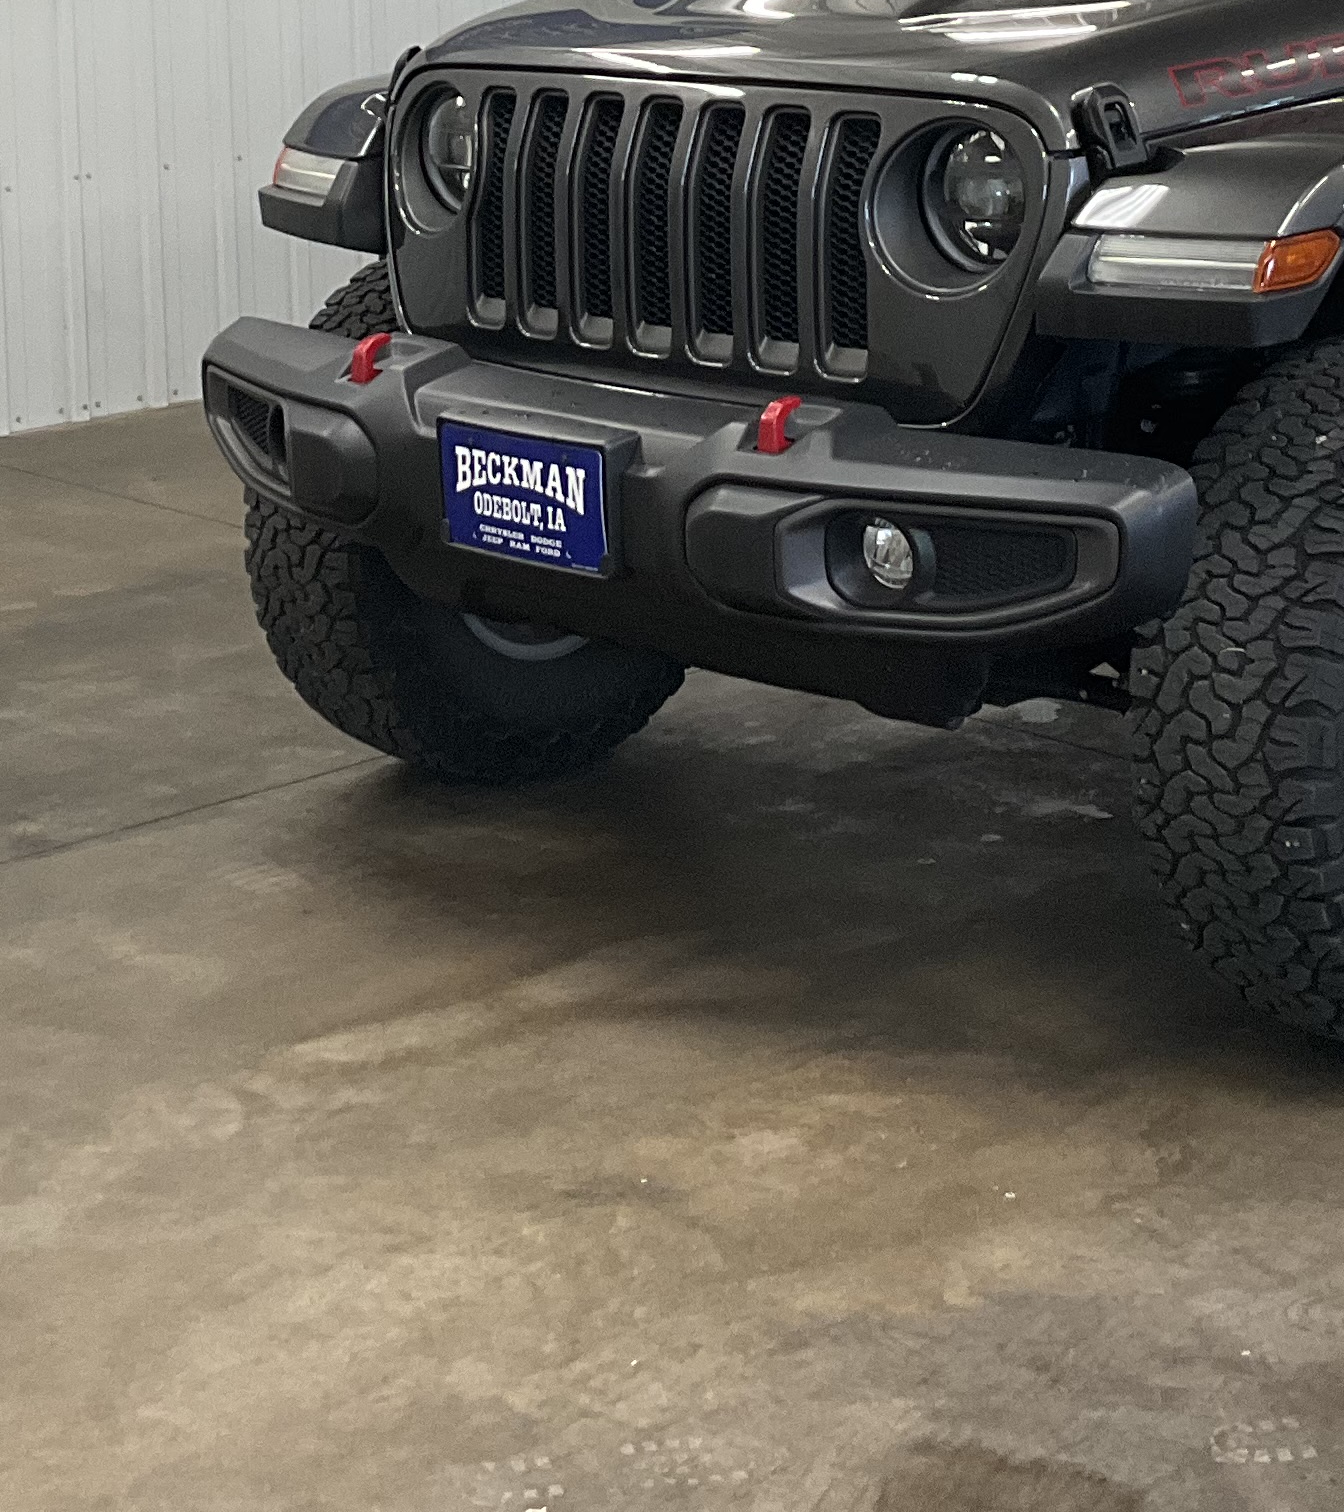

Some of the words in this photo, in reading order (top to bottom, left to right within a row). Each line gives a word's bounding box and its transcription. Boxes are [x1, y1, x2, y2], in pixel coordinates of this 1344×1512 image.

[455, 445, 586, 516] BECKMAN
[473, 491, 544, 531] ODEBOLT,
[547, 507, 567, 532] IA
[480, 524, 524, 540] CHRYSLER
[531, 535, 562, 548] DODGE
[482, 534, 503, 544] JEEP
[509, 540, 530, 551] RAM
[536, 546, 561, 557] FORD
